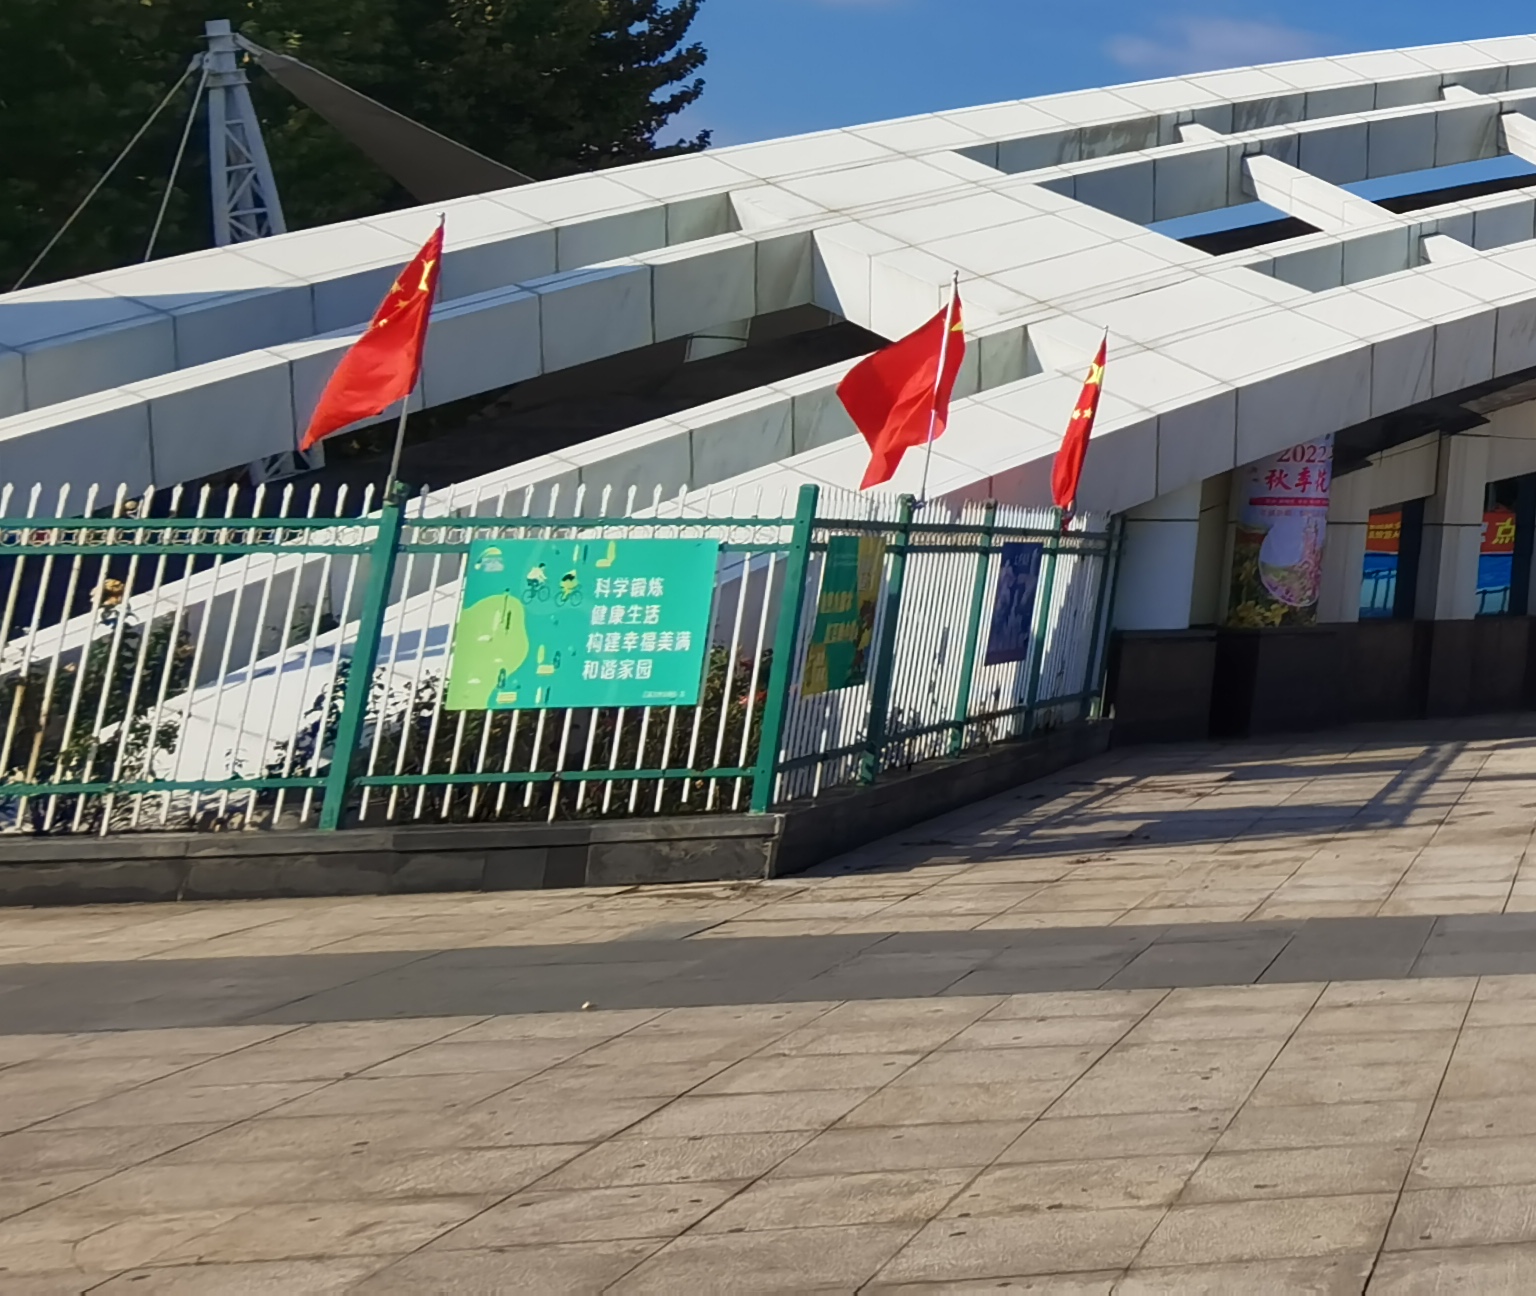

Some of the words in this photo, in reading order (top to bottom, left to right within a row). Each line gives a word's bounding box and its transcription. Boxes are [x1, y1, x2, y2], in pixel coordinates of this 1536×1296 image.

[1277, 444, 1334, 463] 2022
[594, 577, 664, 599] 科学锻炼
[590, 604, 661, 625] 健康生活
[586, 631, 692, 653] 构建幸福美满
[582, 658, 653, 681] 和谐家园
